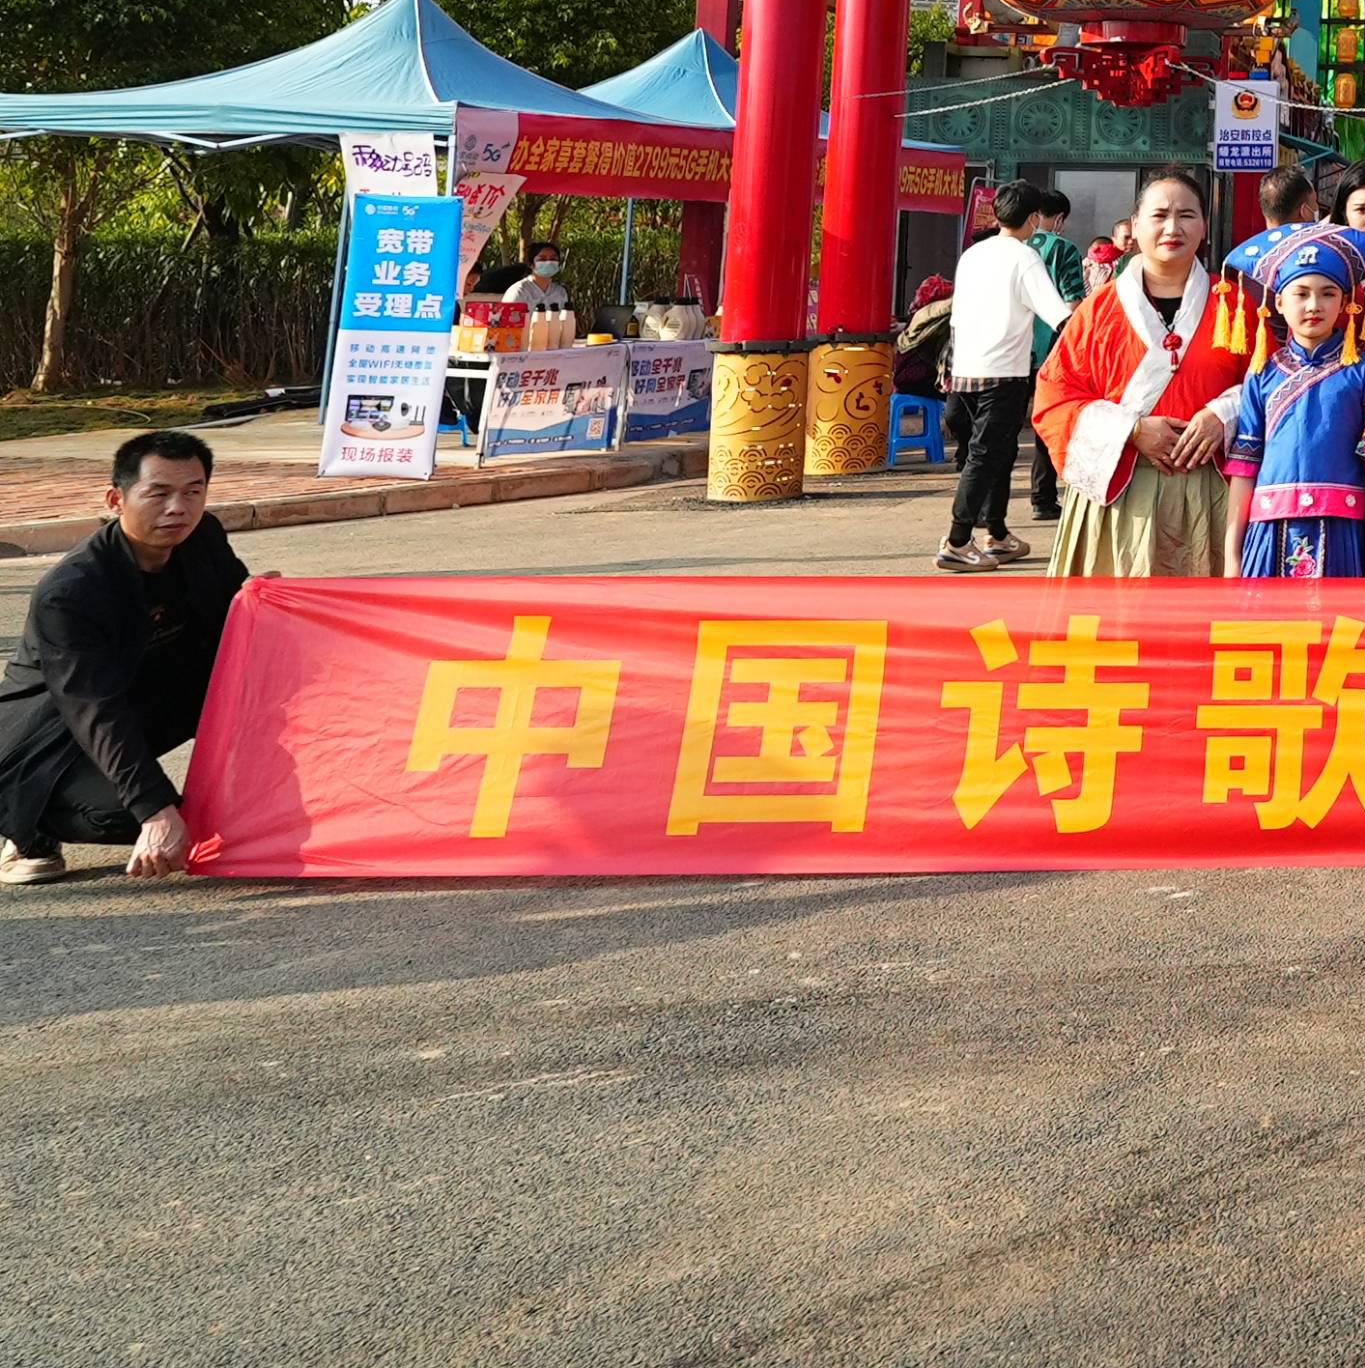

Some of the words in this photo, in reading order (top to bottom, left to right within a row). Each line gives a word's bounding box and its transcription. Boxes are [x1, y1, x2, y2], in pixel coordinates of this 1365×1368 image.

[1219, 129, 1272, 142] 治安防控点
[510, 135, 734, 184] 办全家享套餐得价值2799元5G手机大
[376, 228, 435, 255] 宽带
[371, 260, 431, 288] 业务
[352, 292, 444, 320] 受理点
[340, 446, 414, 464] 现场报装
